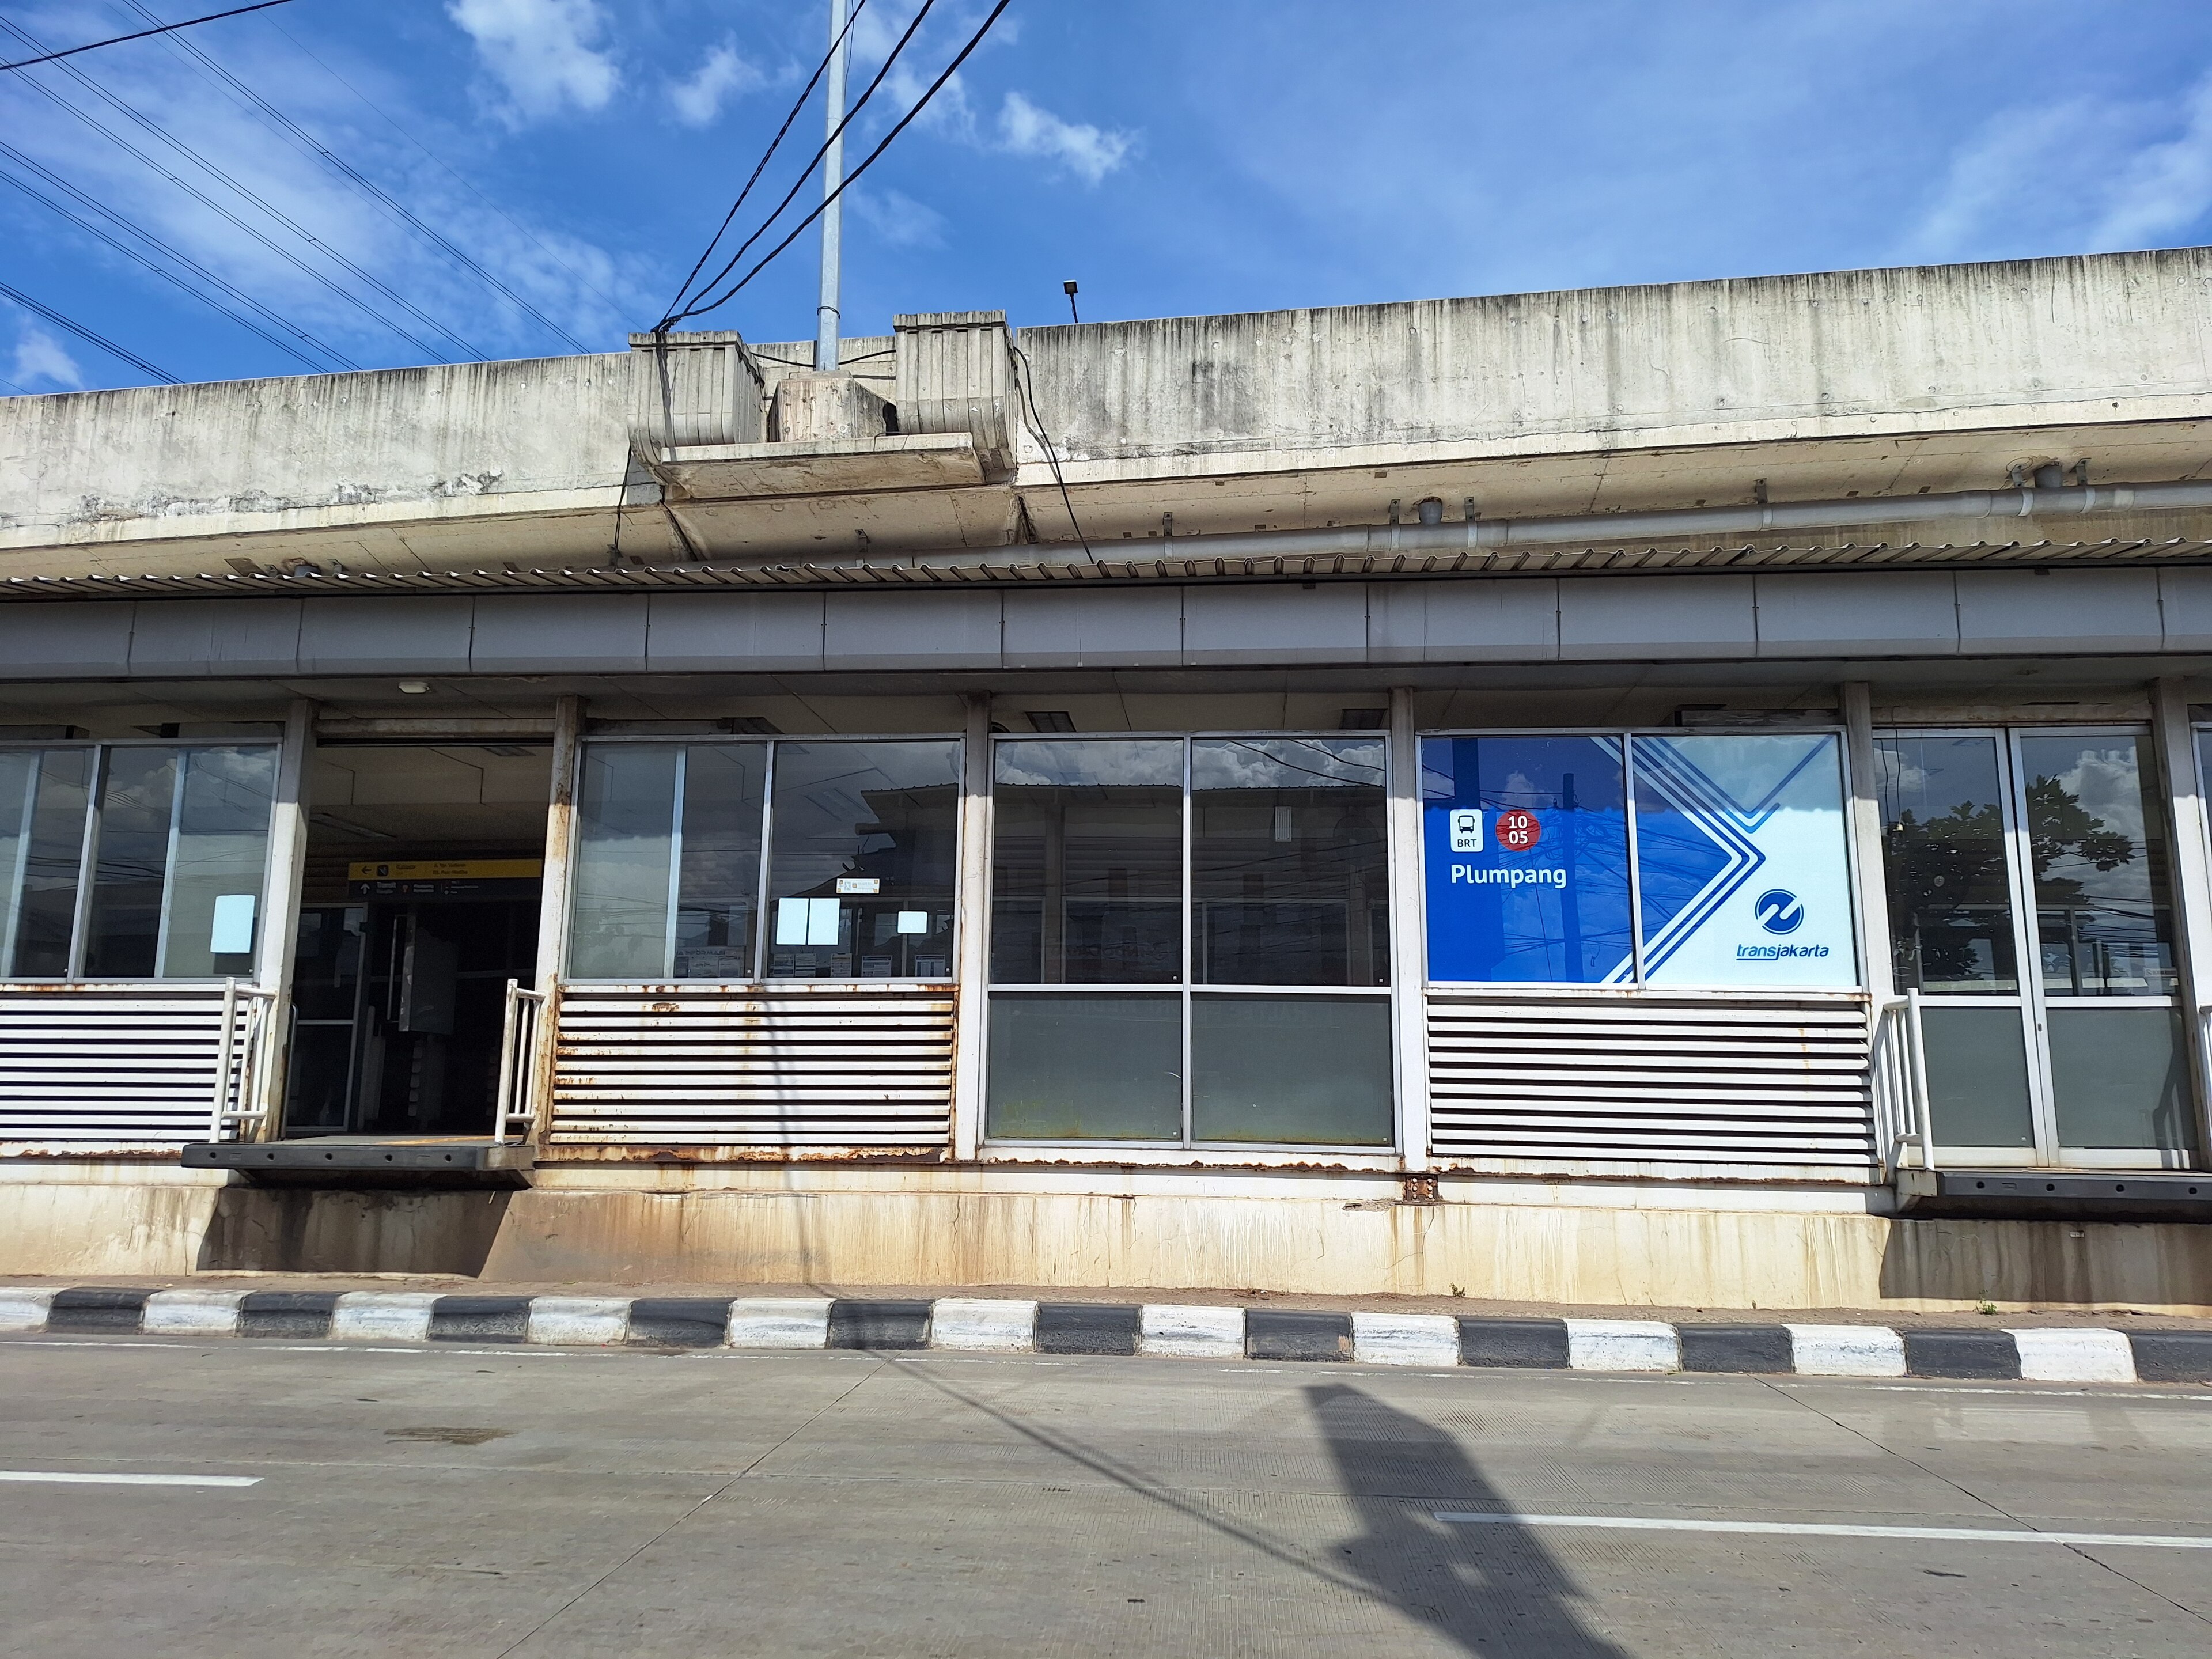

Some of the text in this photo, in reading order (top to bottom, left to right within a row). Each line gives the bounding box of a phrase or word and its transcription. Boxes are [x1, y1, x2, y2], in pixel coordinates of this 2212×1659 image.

[1508, 816, 1528, 829] 10
[1457, 839, 1477, 847] BRT
[1509, 831, 1528, 844] 05
[1451, 865, 1566, 889] Plumpang
[1736, 944, 1830, 961] transjakarta
